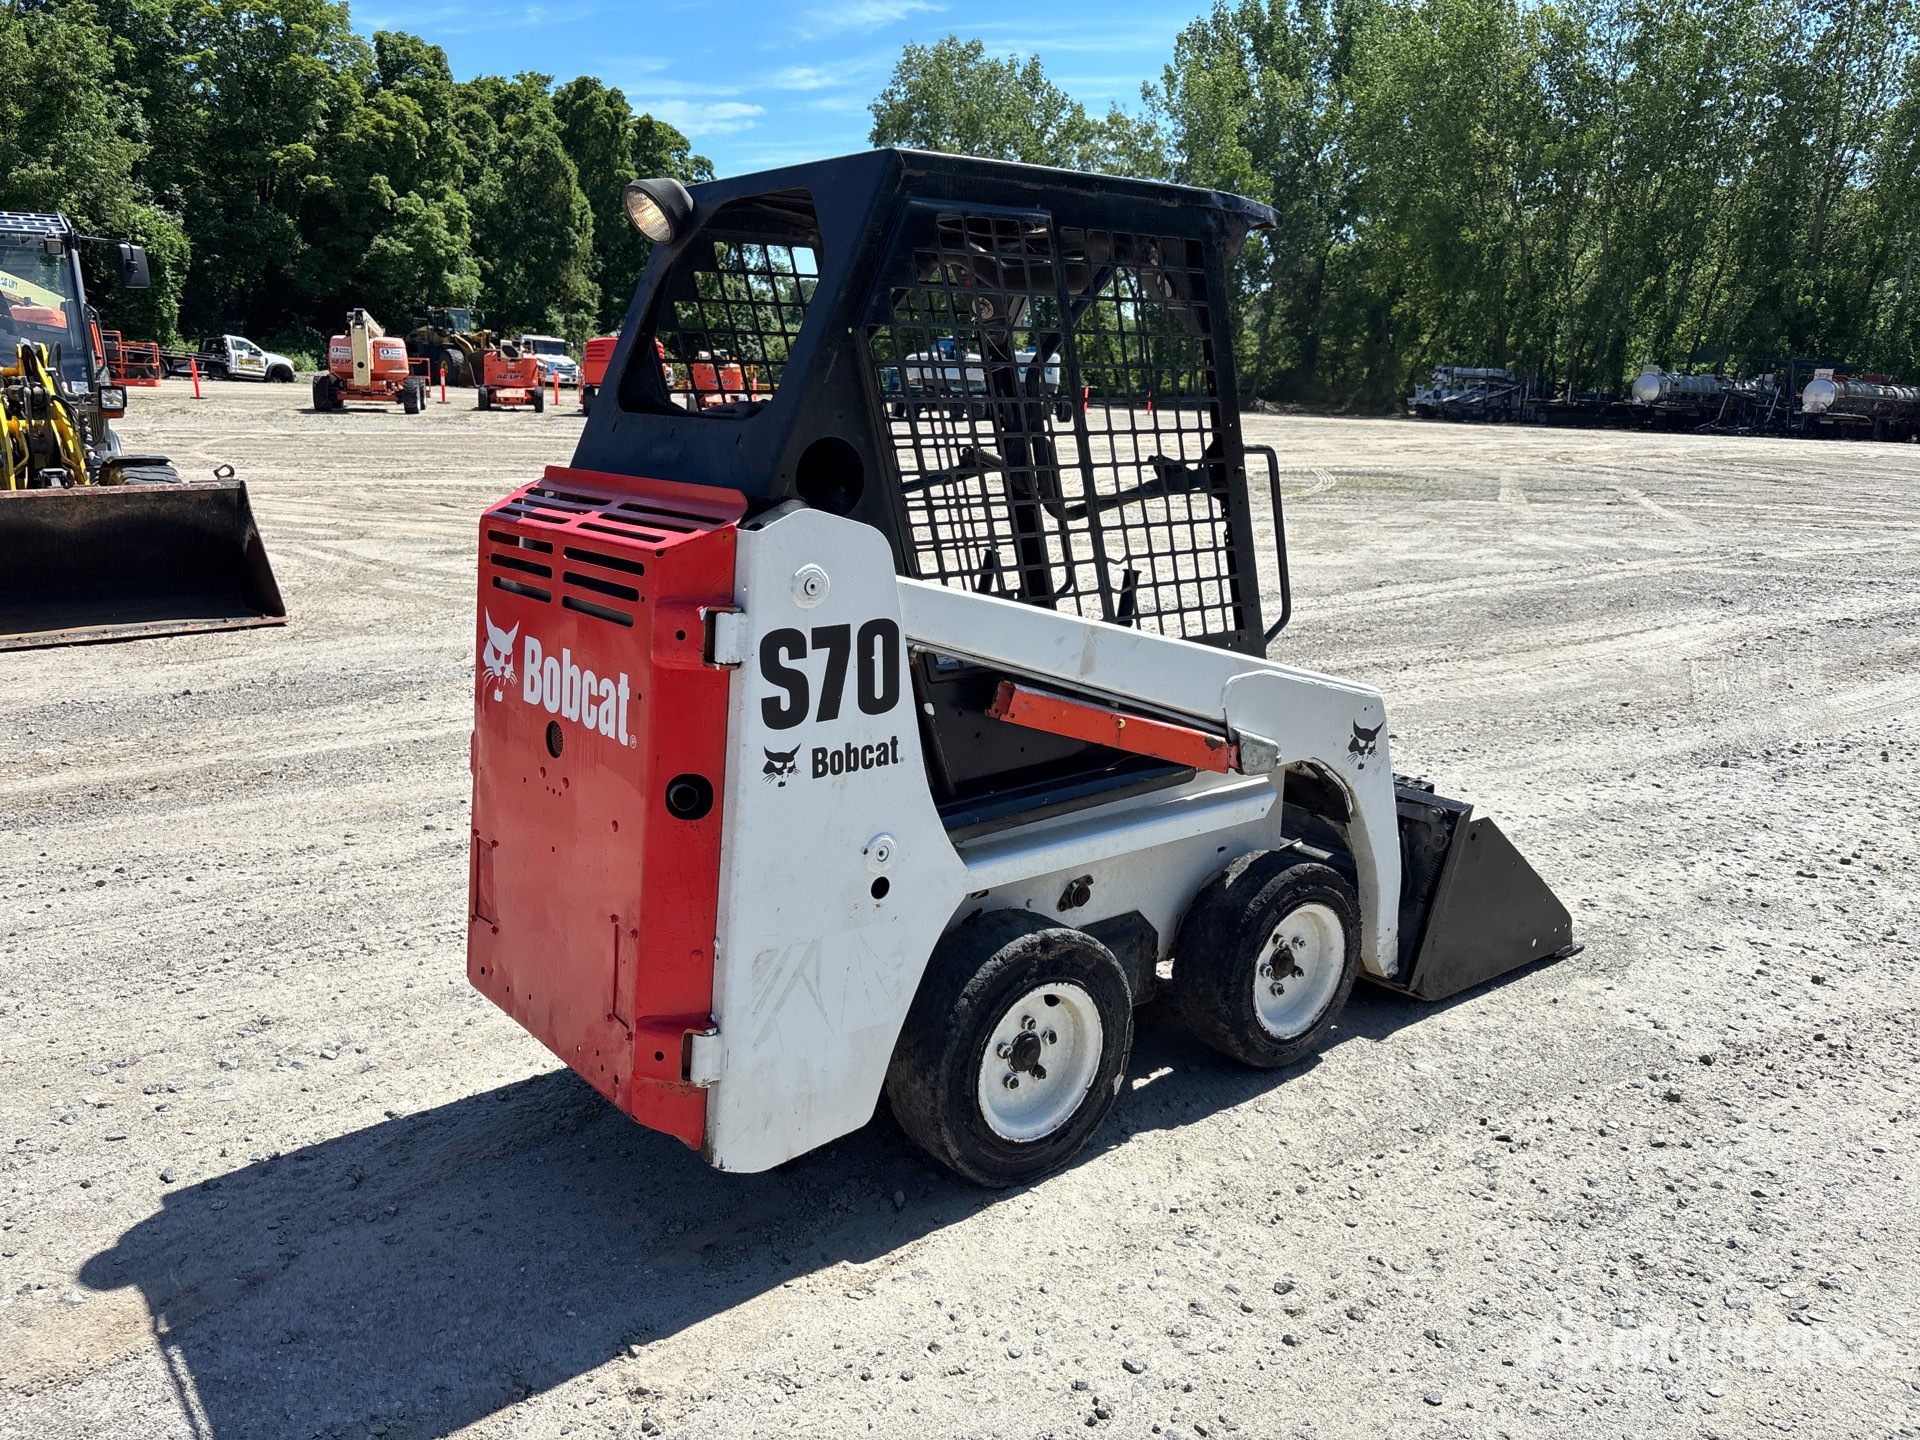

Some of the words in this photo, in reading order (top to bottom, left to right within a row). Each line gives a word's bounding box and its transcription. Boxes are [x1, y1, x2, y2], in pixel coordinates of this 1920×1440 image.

[524, 635, 631, 747] Bobcat
[760, 618, 900, 730] S70
[812, 735, 899, 779] Bobcat
